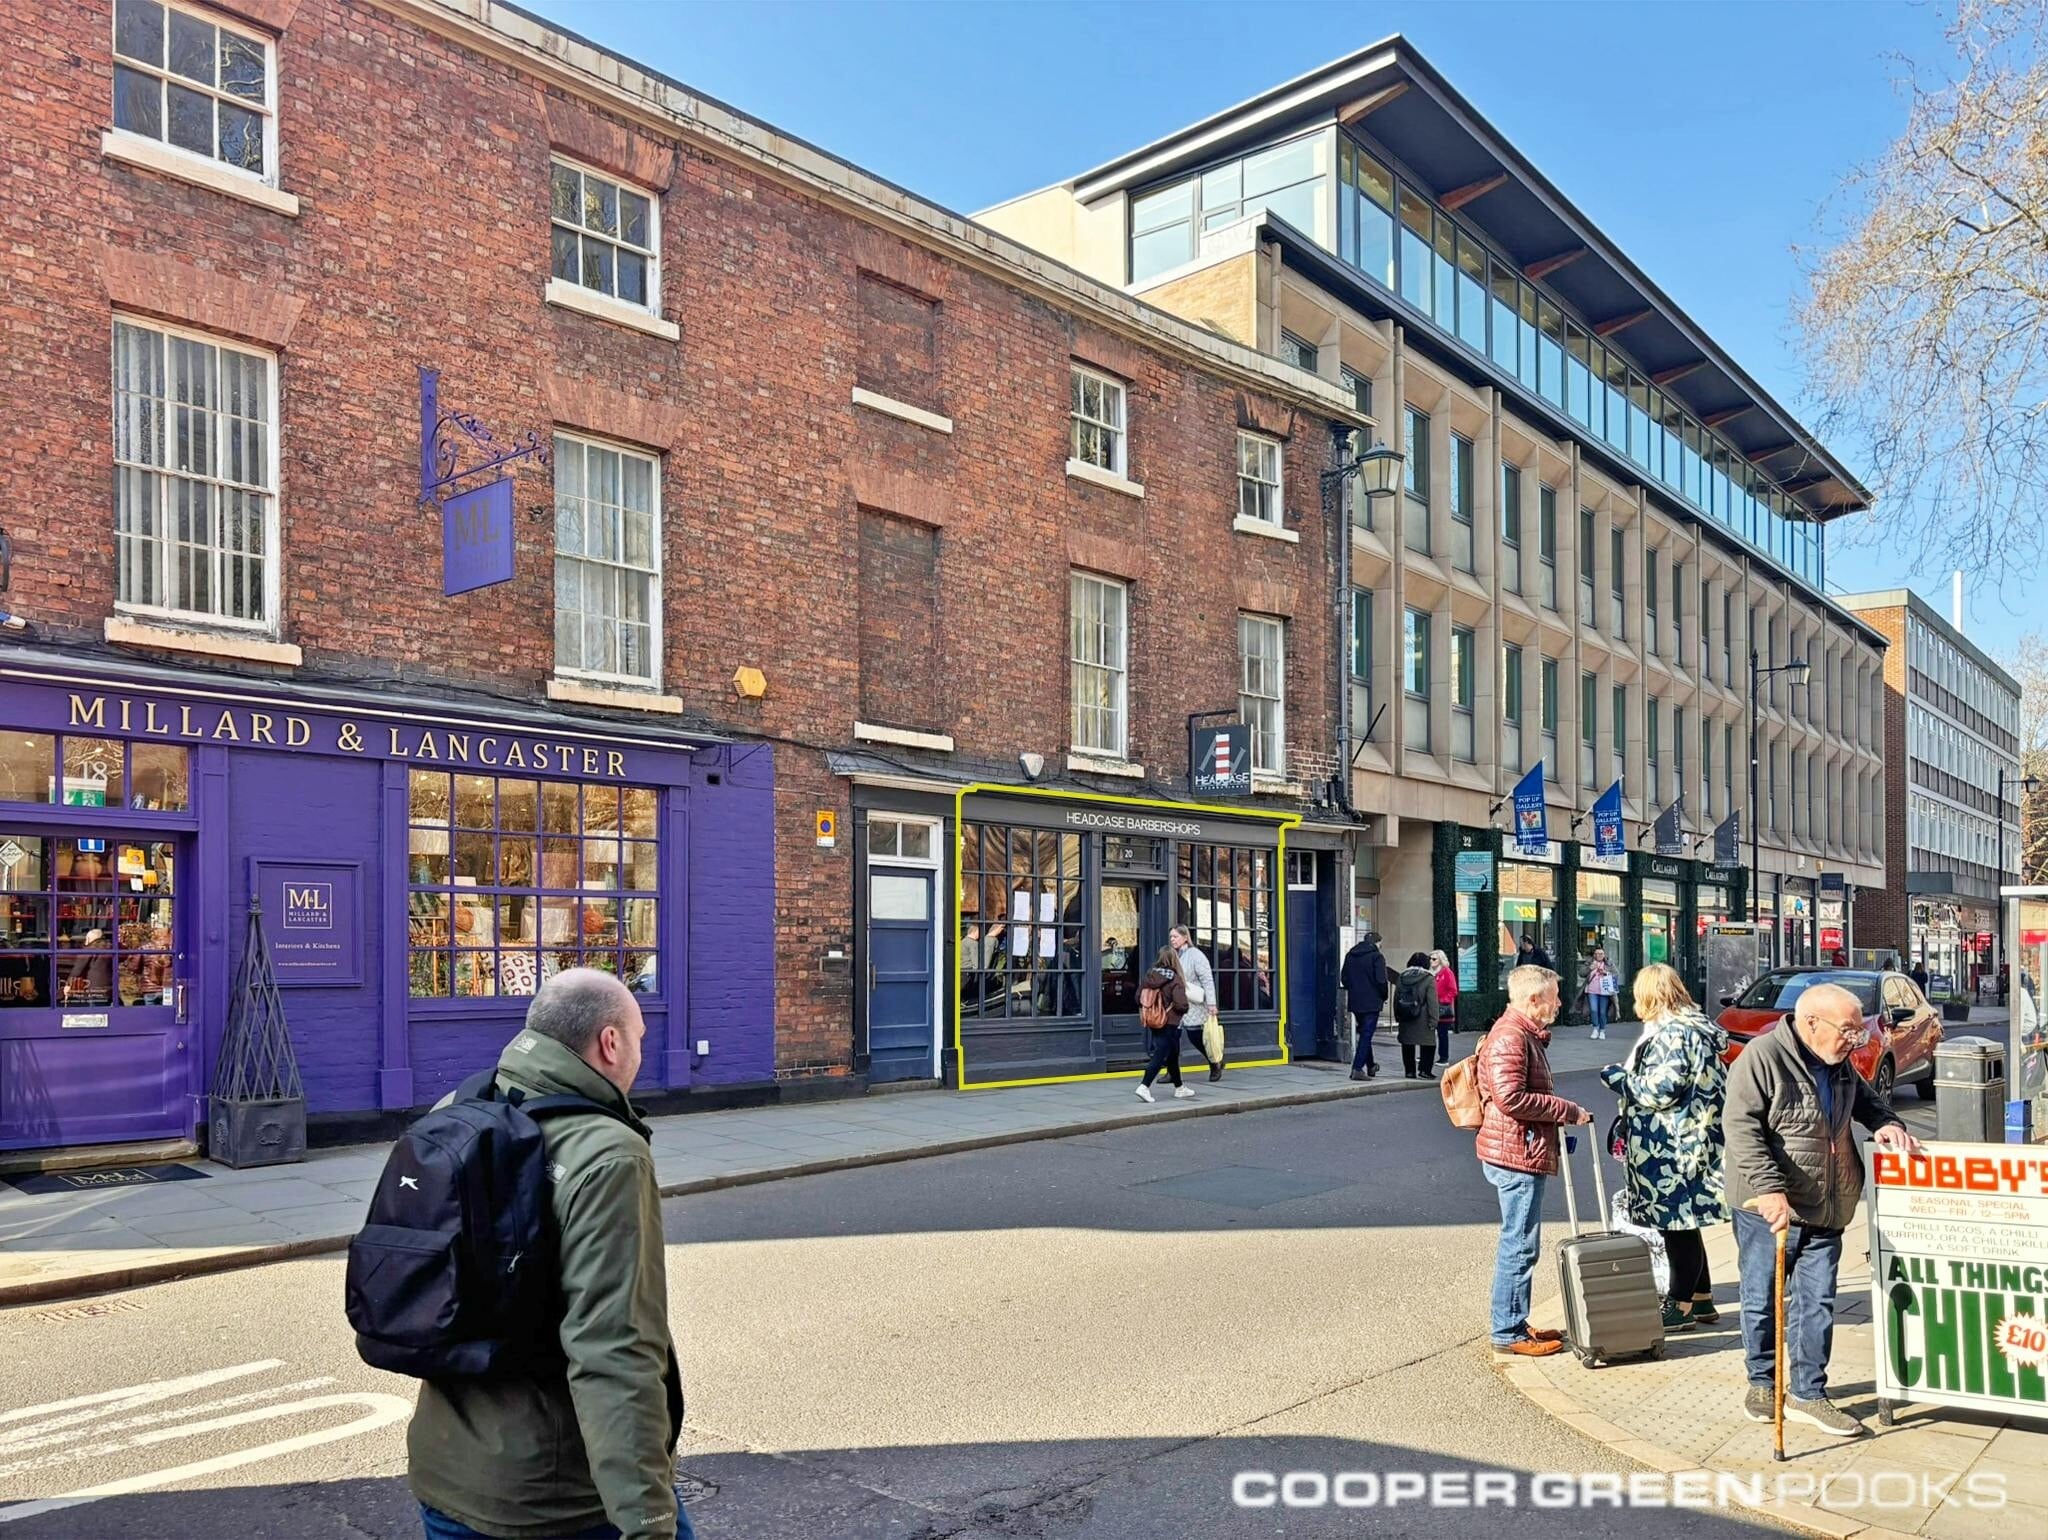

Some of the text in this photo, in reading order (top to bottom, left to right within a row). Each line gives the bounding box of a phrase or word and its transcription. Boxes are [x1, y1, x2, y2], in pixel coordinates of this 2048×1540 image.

[68, 694, 626, 777] MILLARD & LANCASTER
[83, 761, 108, 783] 18
[1066, 811, 1201, 836] HEADCASE BARBERSHOPS
[1124, 849, 1133, 858] 20
[1910, 1195, 2027, 1211] SEASONAL SPECIAL
[1903, 1221, 1940, 1232] CHILLI
[1989, 1227, 1997, 1236] A
[2000, 1228, 2039, 1239] CHILLI
[1939, 1233, 1957, 1242] OR
[1960, 1235, 1969, 1243] A
[1972, 1236, 2010, 1247] CHILLI
[2013, 1239, 2048, 1249] SKILL
[1936, 1242, 1944, 1250] A
[1947, 1243, 1977, 1253] SOFT
[1983, 1246, 2020, 1257] DRINK
[1887, 1255, 2048, 1295] ALL THING
[1887, 1283, 2048, 1403] CHILL
[2005, 1324, 2046, 1353] £10
